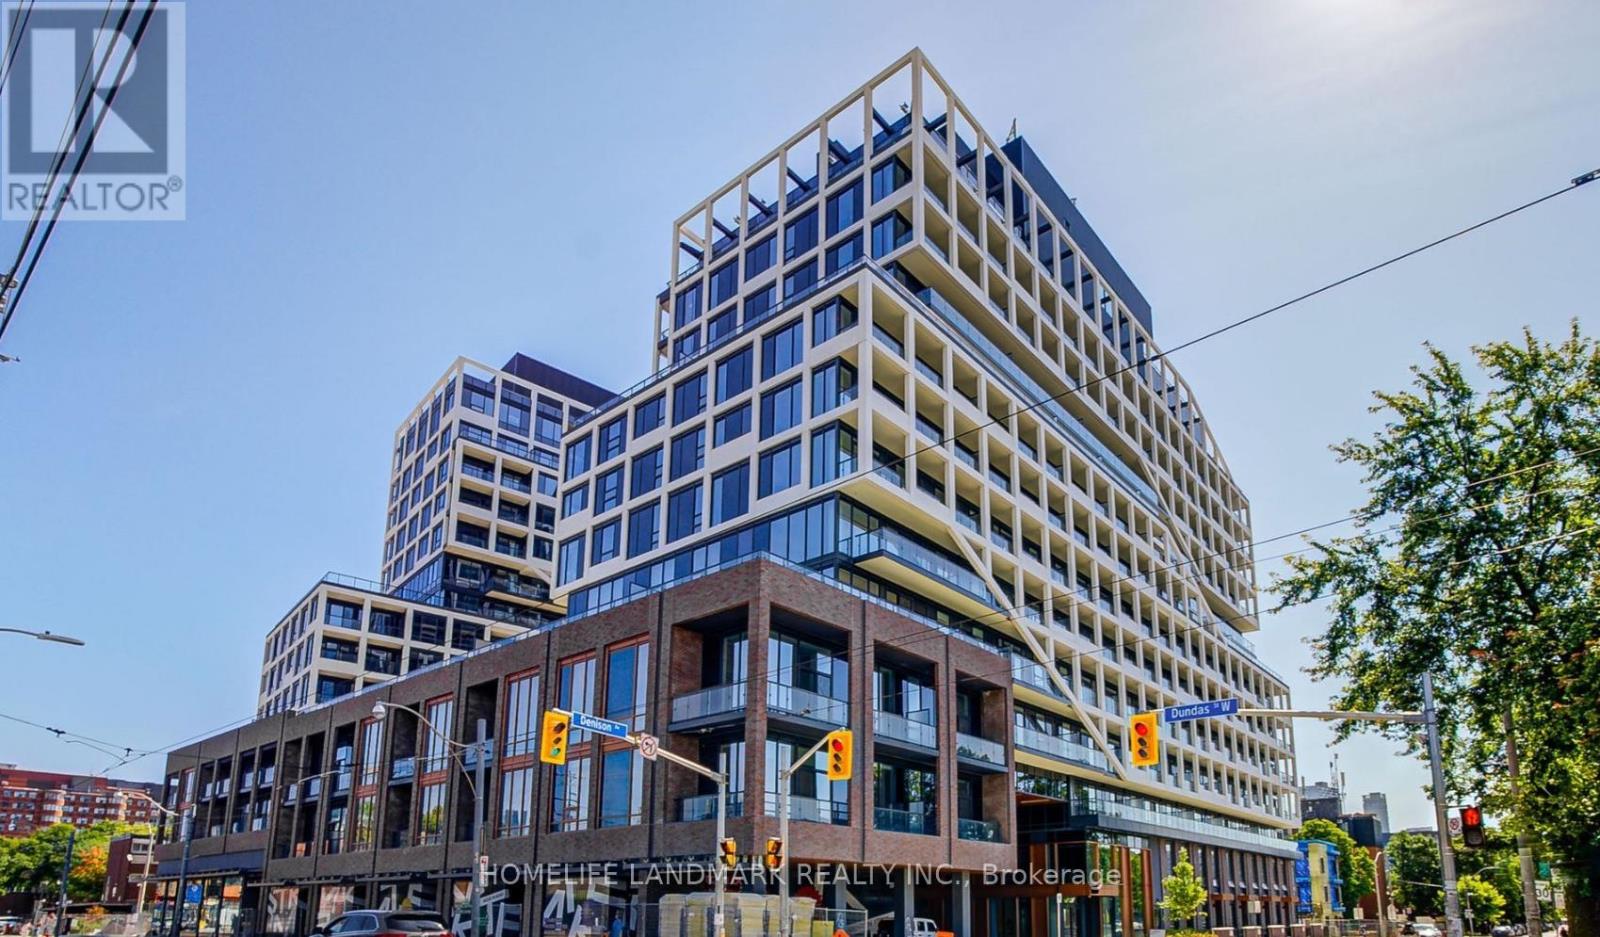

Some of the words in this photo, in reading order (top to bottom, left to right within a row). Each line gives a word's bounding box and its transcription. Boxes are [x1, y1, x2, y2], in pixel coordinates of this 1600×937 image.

[1171, 705, 1210, 718] Dundas
[1221, 701, 1230, 711] W
[580, 715, 612, 732] Denison
